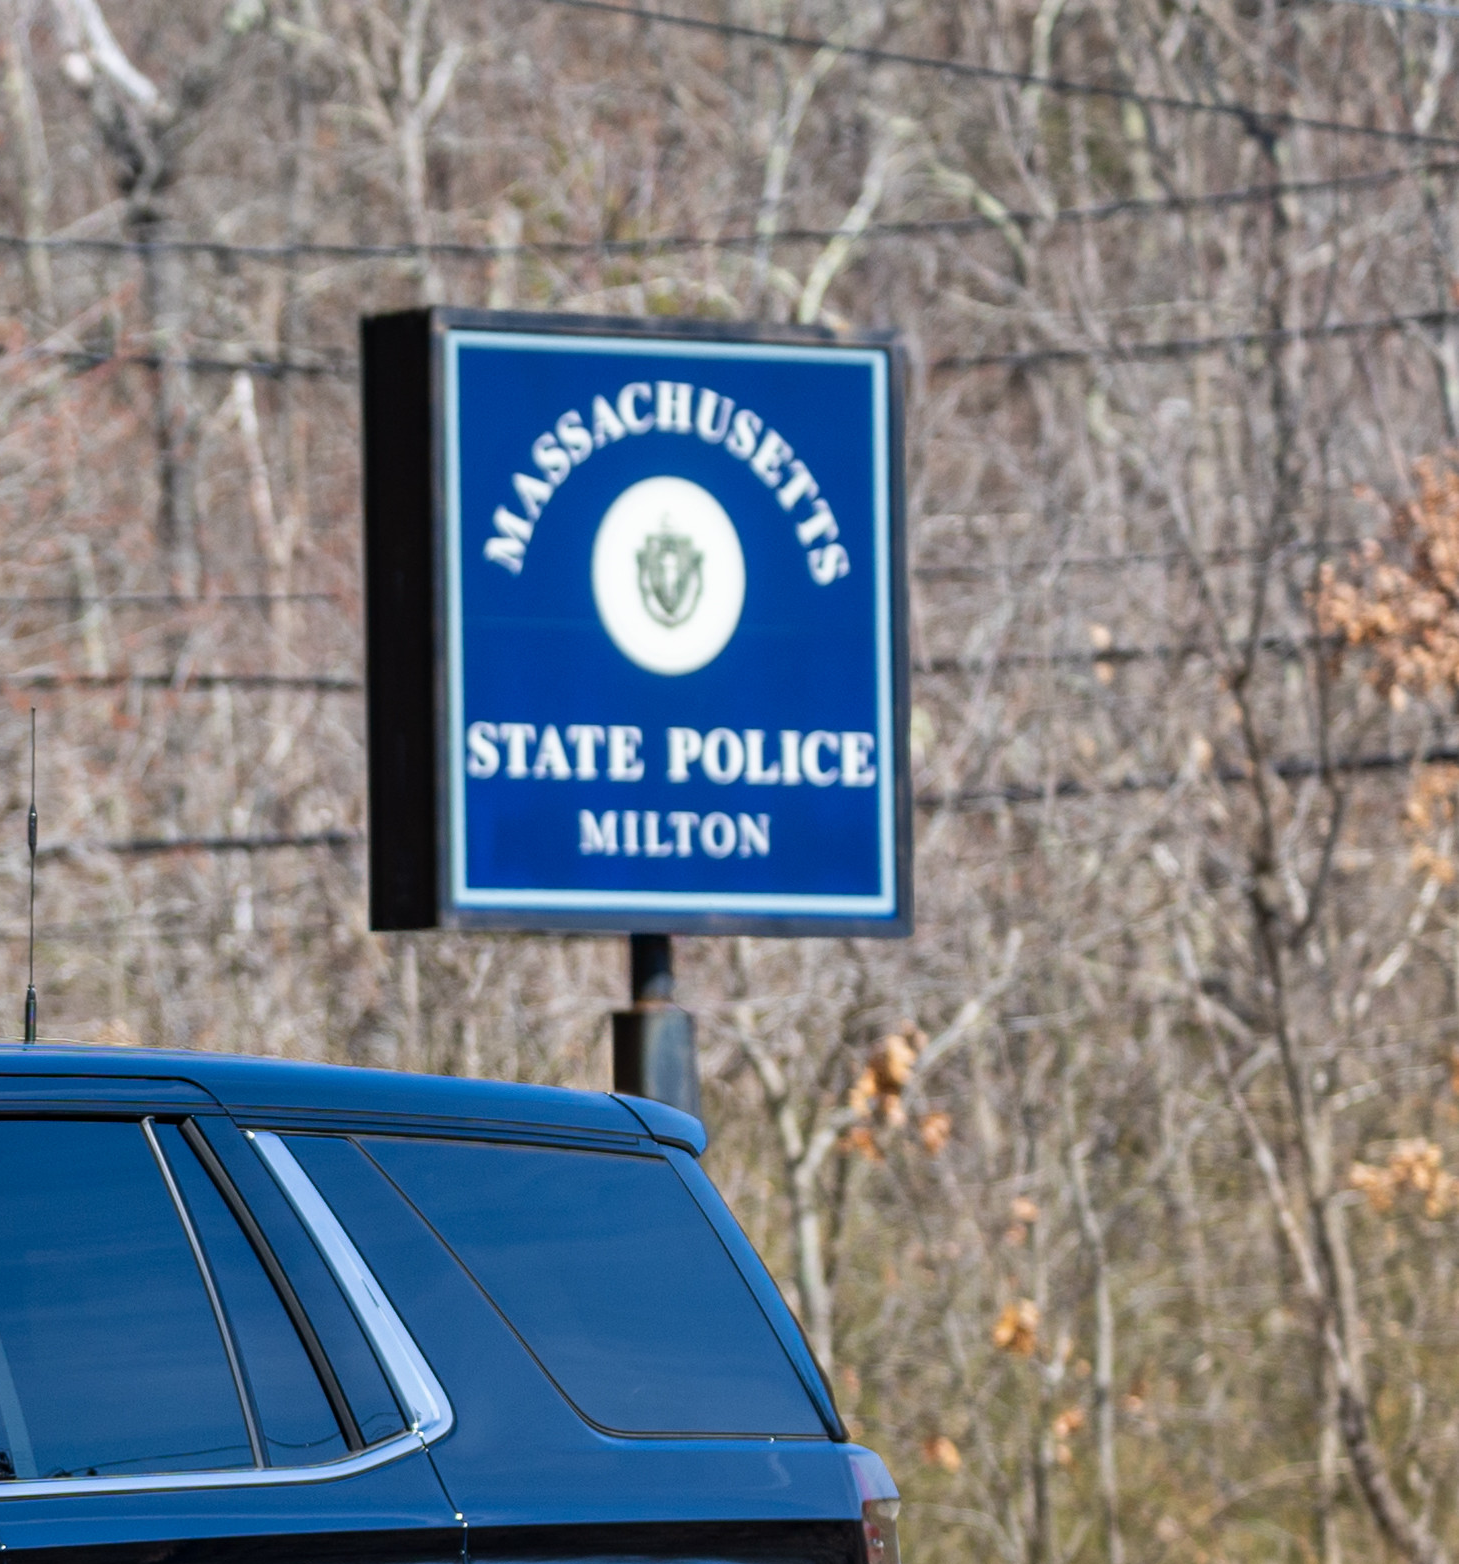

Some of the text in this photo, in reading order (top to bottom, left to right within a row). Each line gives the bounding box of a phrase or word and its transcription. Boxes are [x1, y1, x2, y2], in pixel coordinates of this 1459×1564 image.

[485, 381, 850, 585] MASSACHUSETTS
[467, 722, 876, 786] STATE POLICE
[579, 809, 771, 857] MILTON
